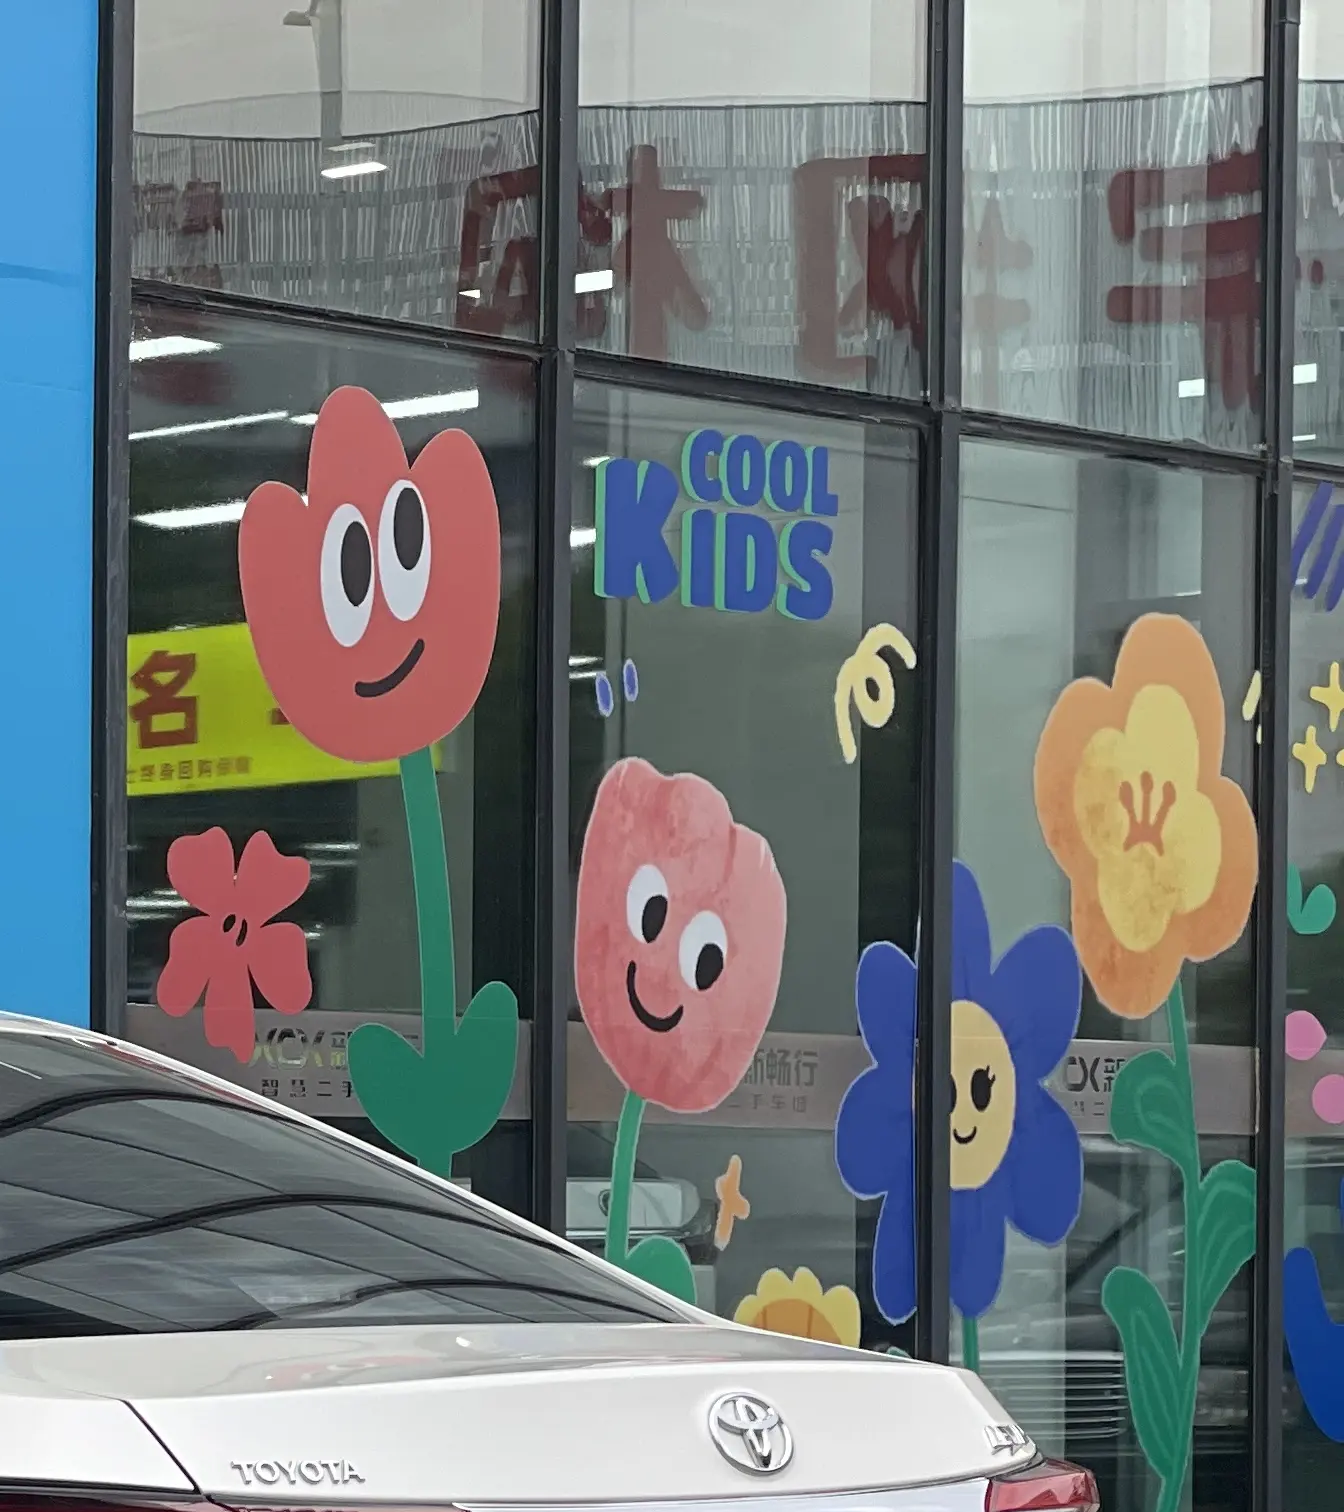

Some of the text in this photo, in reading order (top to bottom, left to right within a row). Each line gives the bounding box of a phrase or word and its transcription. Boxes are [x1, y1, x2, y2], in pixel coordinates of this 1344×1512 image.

[679, 428, 838, 517] COOL
[593, 457, 834, 620] KIDS
[230, 1459, 366, 1485] TOYOTA
